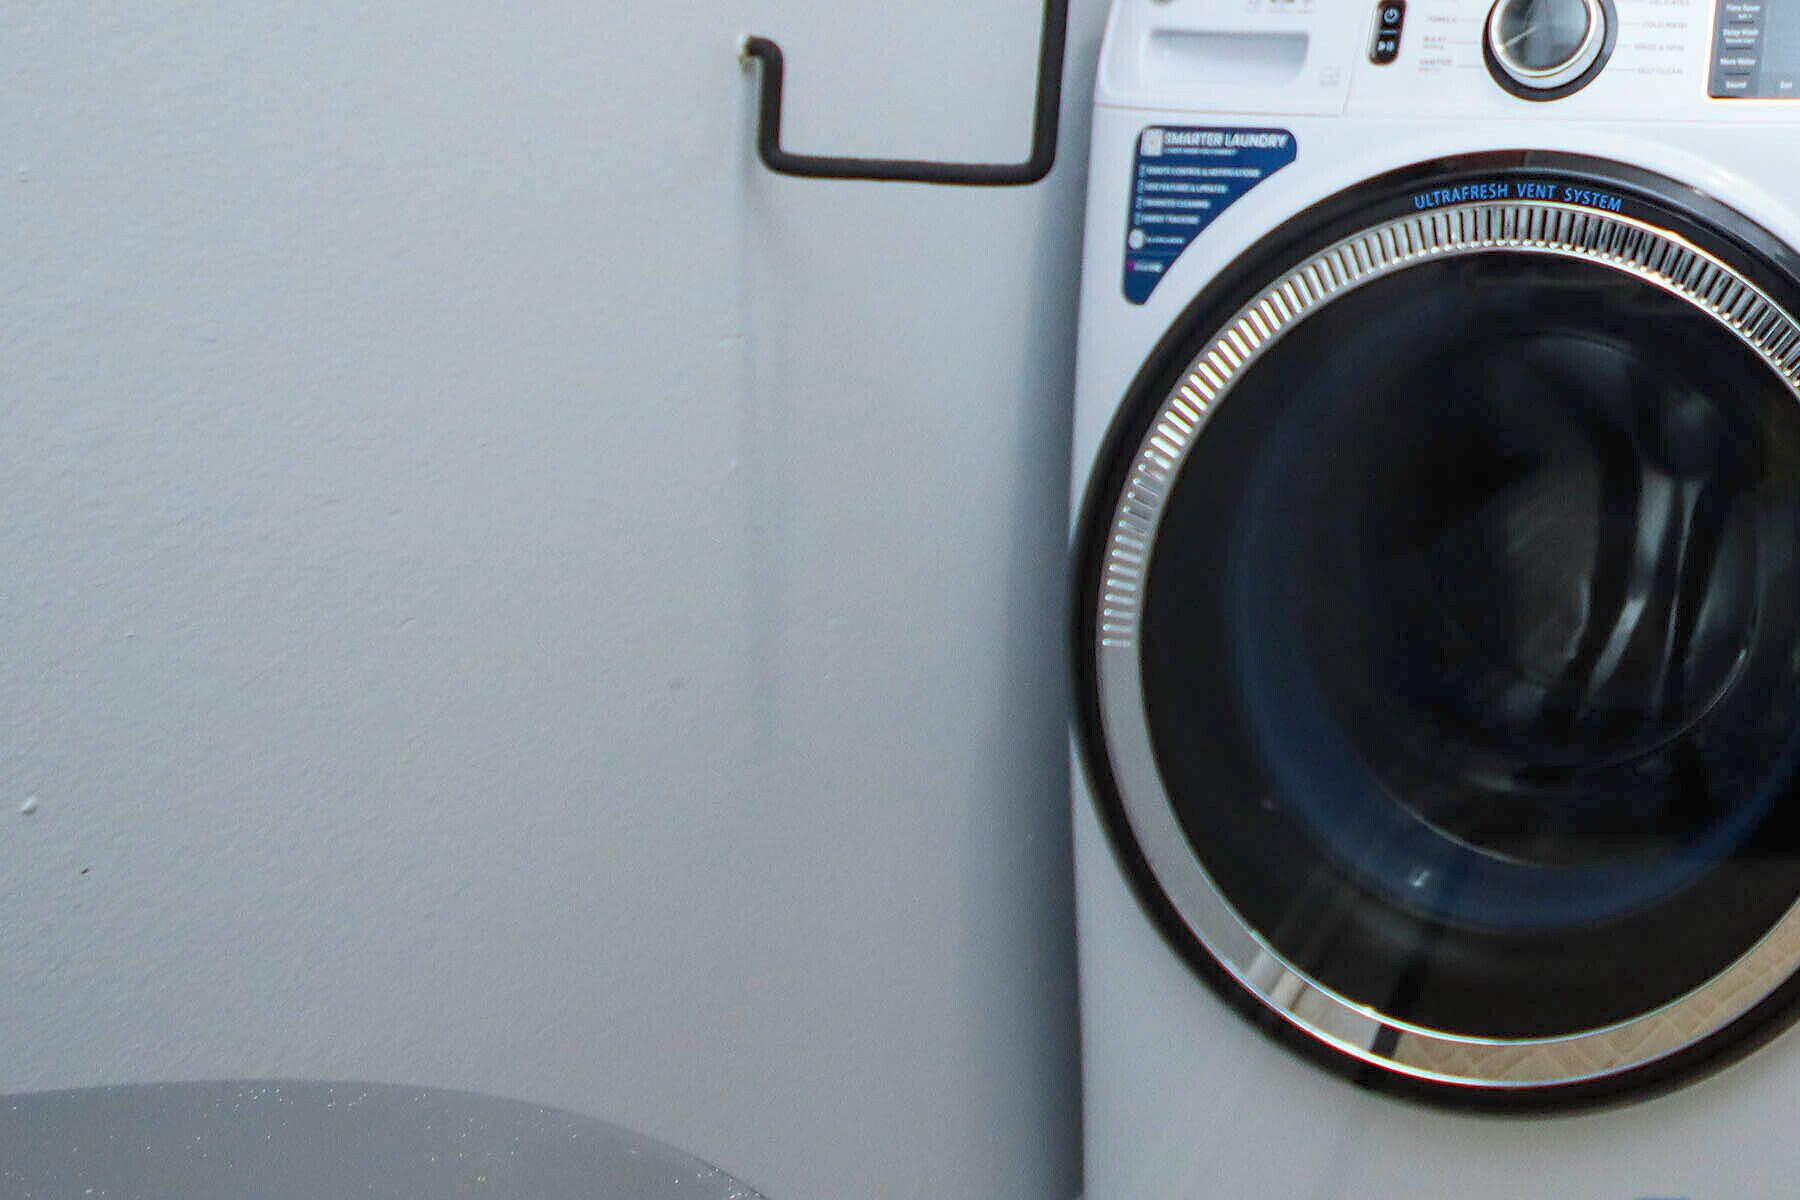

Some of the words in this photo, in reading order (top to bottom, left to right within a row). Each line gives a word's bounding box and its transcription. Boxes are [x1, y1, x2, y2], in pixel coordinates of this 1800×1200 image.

[1165, 131, 1224, 147] SMARTER
[1225, 133, 1289, 148] LAUNDRY
[1413, 183, 1508, 210] ULTRAFRESH
[1516, 183, 1557, 199] VENT
[1564, 187, 1622, 212] SYSTEM
